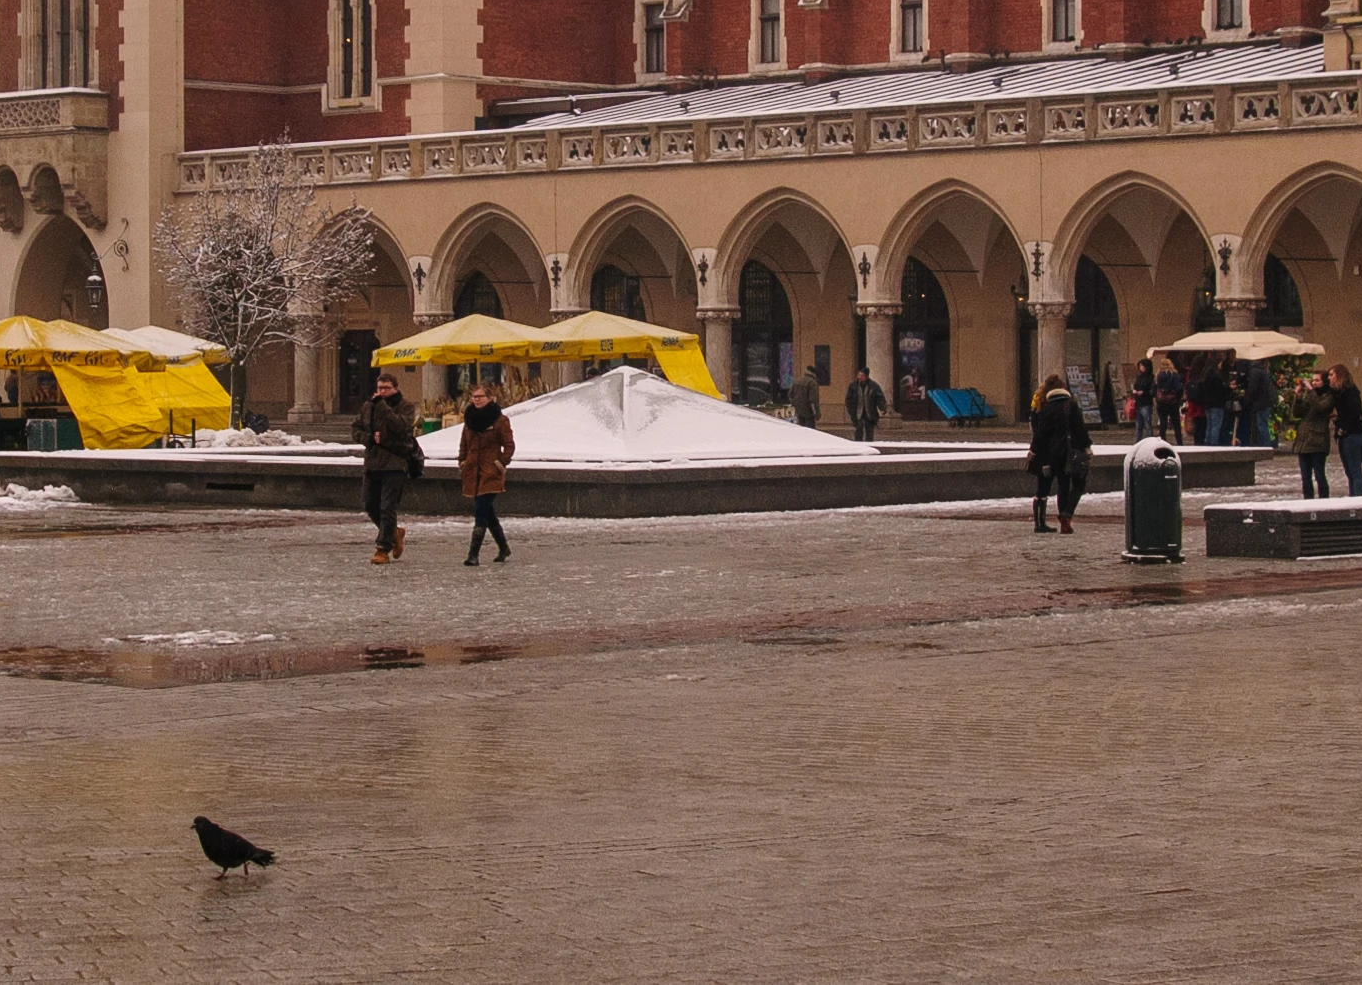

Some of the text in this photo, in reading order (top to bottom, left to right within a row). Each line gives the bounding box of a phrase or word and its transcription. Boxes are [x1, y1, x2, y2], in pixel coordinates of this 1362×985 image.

[541, 341, 564, 352] RMF
[52, 351, 79, 363] RMF
[394, 348, 420, 359] RMF
